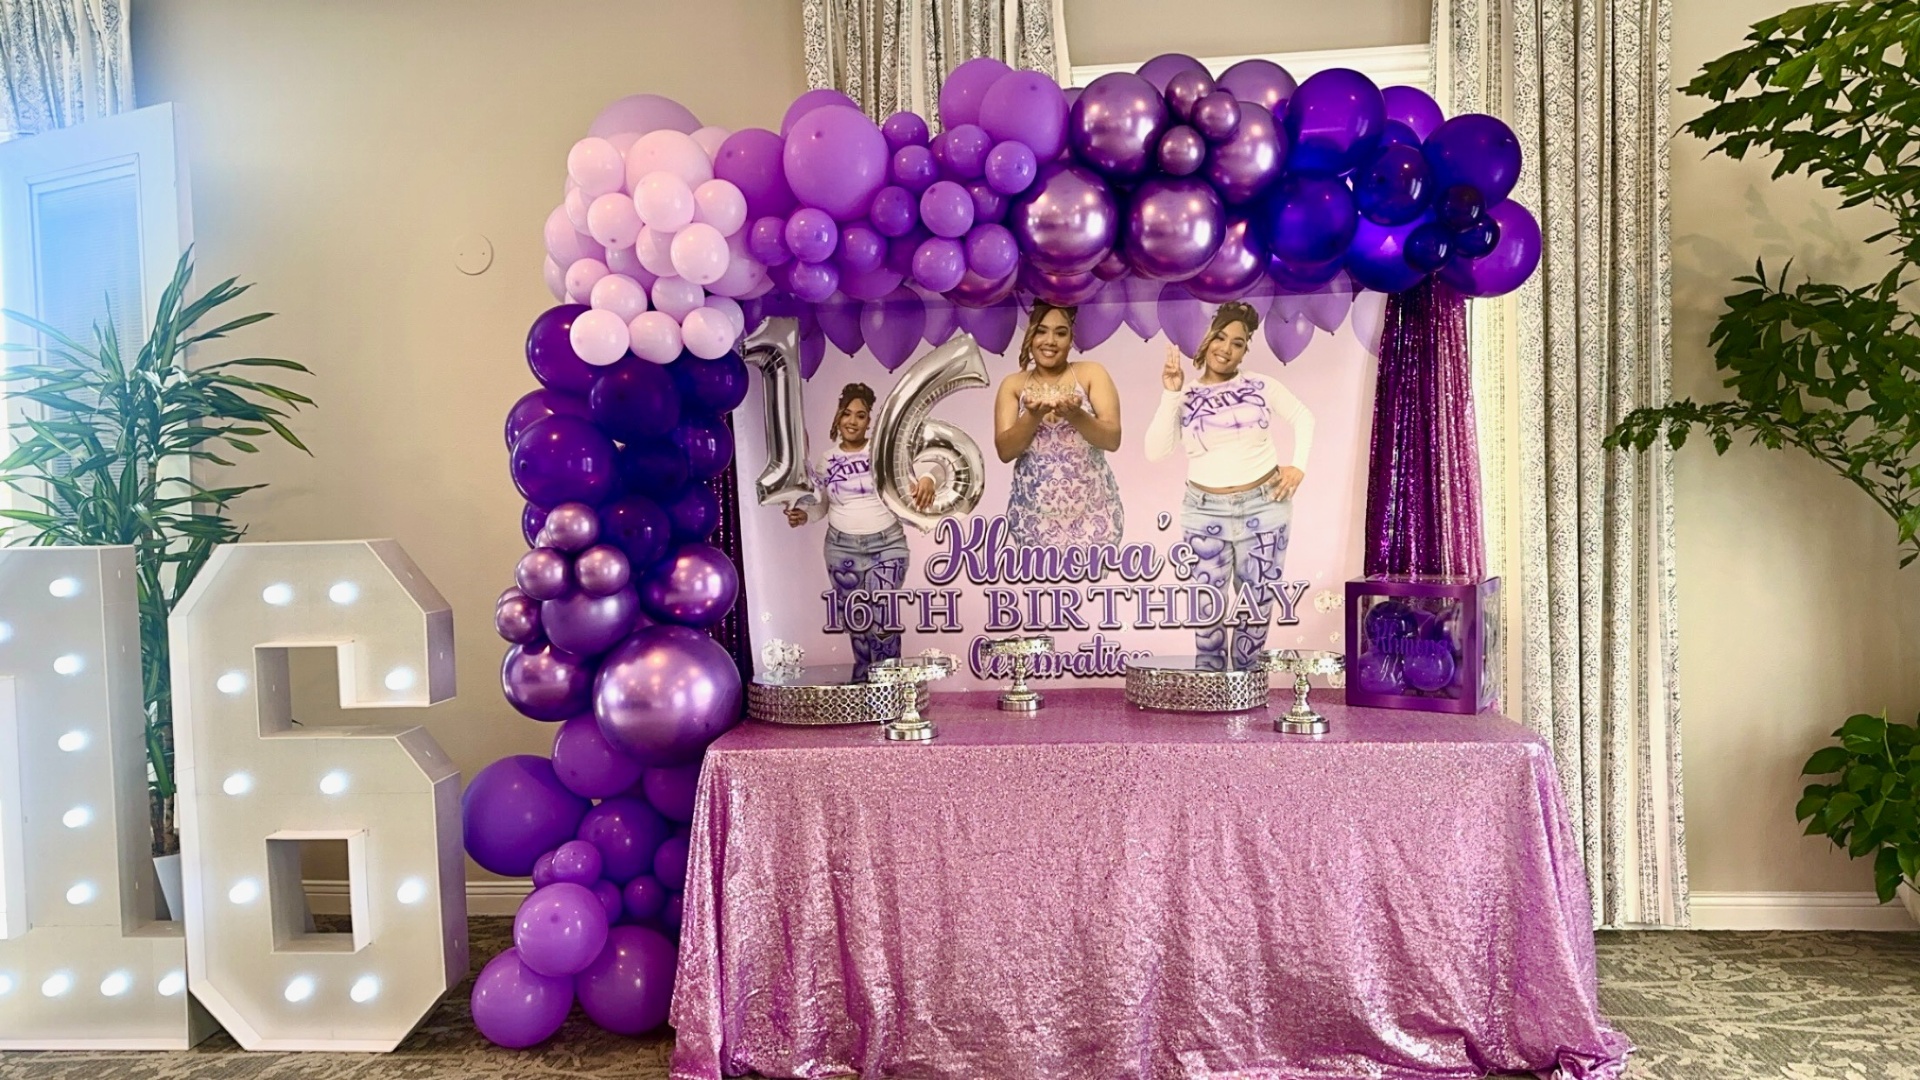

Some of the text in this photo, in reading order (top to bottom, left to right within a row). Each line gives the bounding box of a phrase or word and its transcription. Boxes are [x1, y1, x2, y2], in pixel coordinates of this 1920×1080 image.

[925, 511, 1199, 584] Khmora's
[822, 588, 963, 633] 16TH
[985, 579, 1310, 633] BIRTHDAY
[969, 633, 1153, 680] Ceebratio
